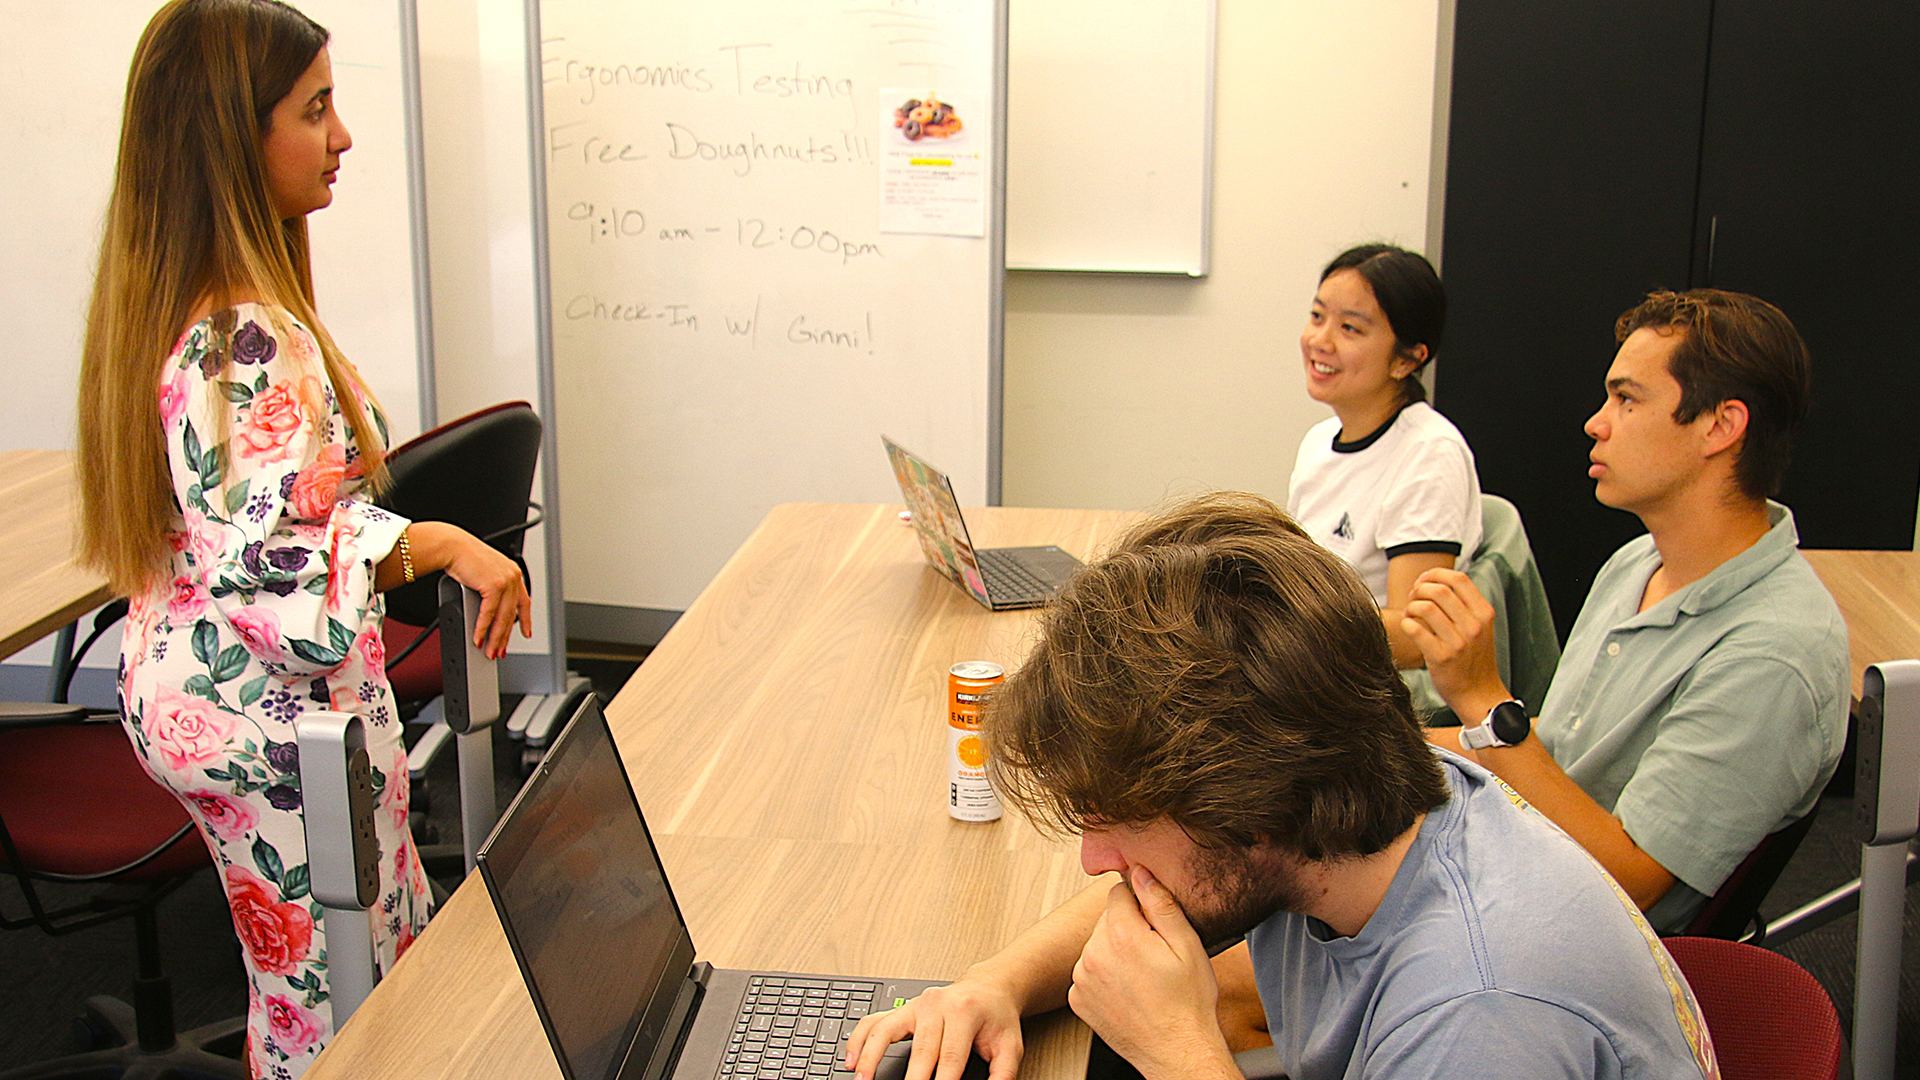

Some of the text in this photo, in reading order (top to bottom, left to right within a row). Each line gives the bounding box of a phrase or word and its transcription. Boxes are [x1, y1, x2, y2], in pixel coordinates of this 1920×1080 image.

[541, 37, 857, 133] Ergonomics Testing
[550, 119, 875, 177] Free Doughnuts!!!
[567, 201, 645, 244] 9:10
[659, 228, 695, 241] am
[787, 311, 873, 356] Ginni!
[957, 770, 986, 778] ORANG
